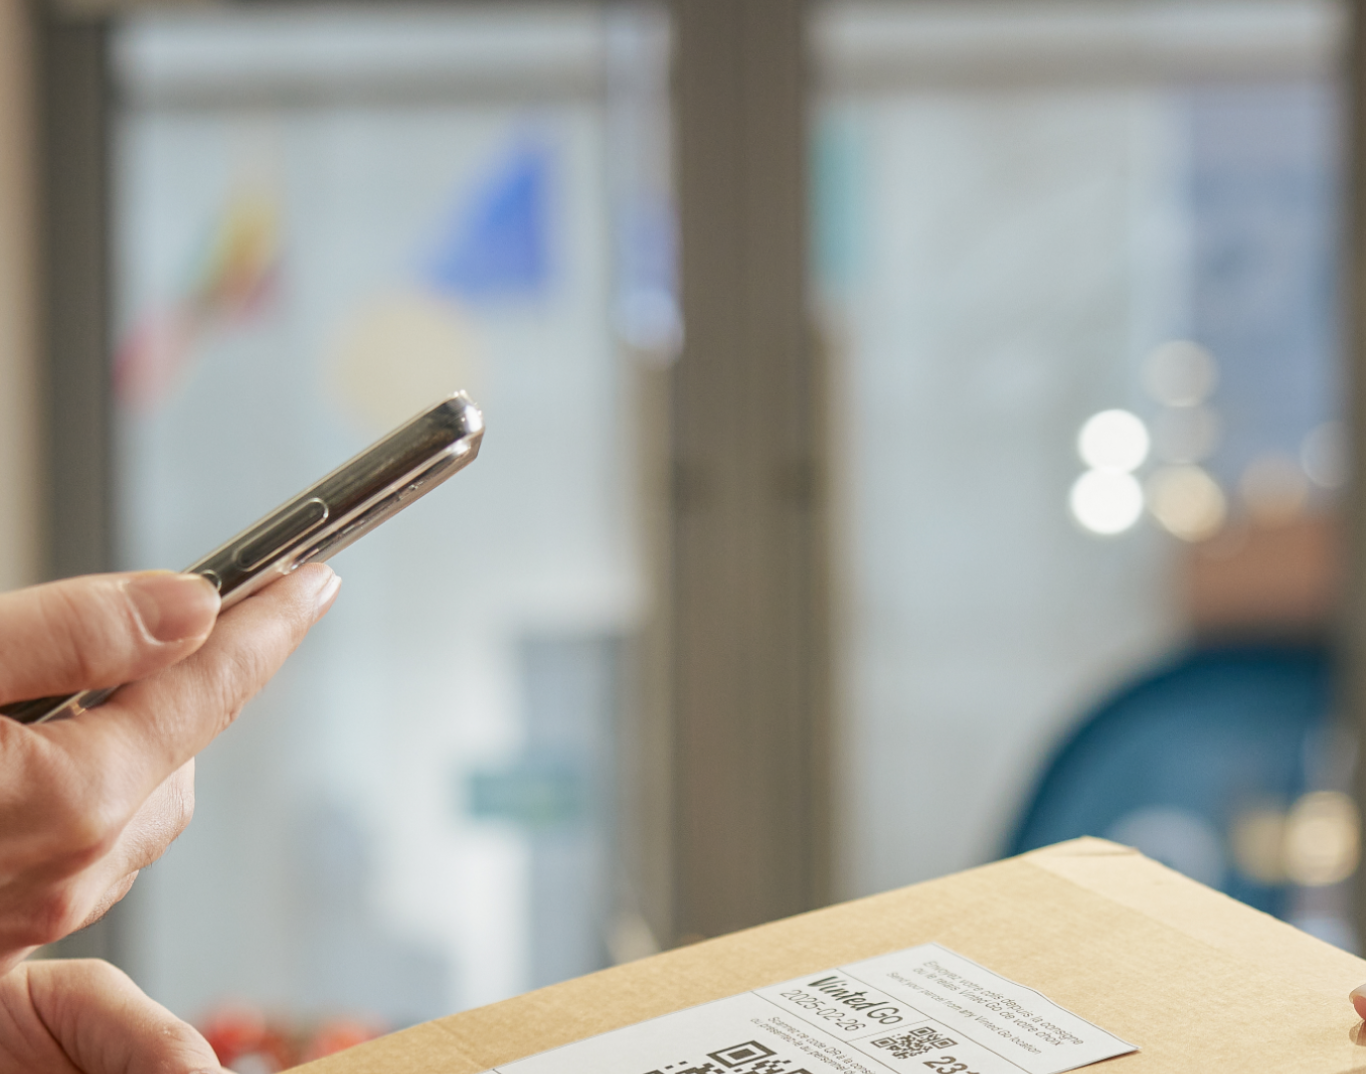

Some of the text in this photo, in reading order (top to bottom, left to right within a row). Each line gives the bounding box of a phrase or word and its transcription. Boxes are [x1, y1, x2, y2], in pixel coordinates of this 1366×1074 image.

[779, 990, 867, 1031] 2025-02-26
[807, 976, 903, 1025] Vinted Go
